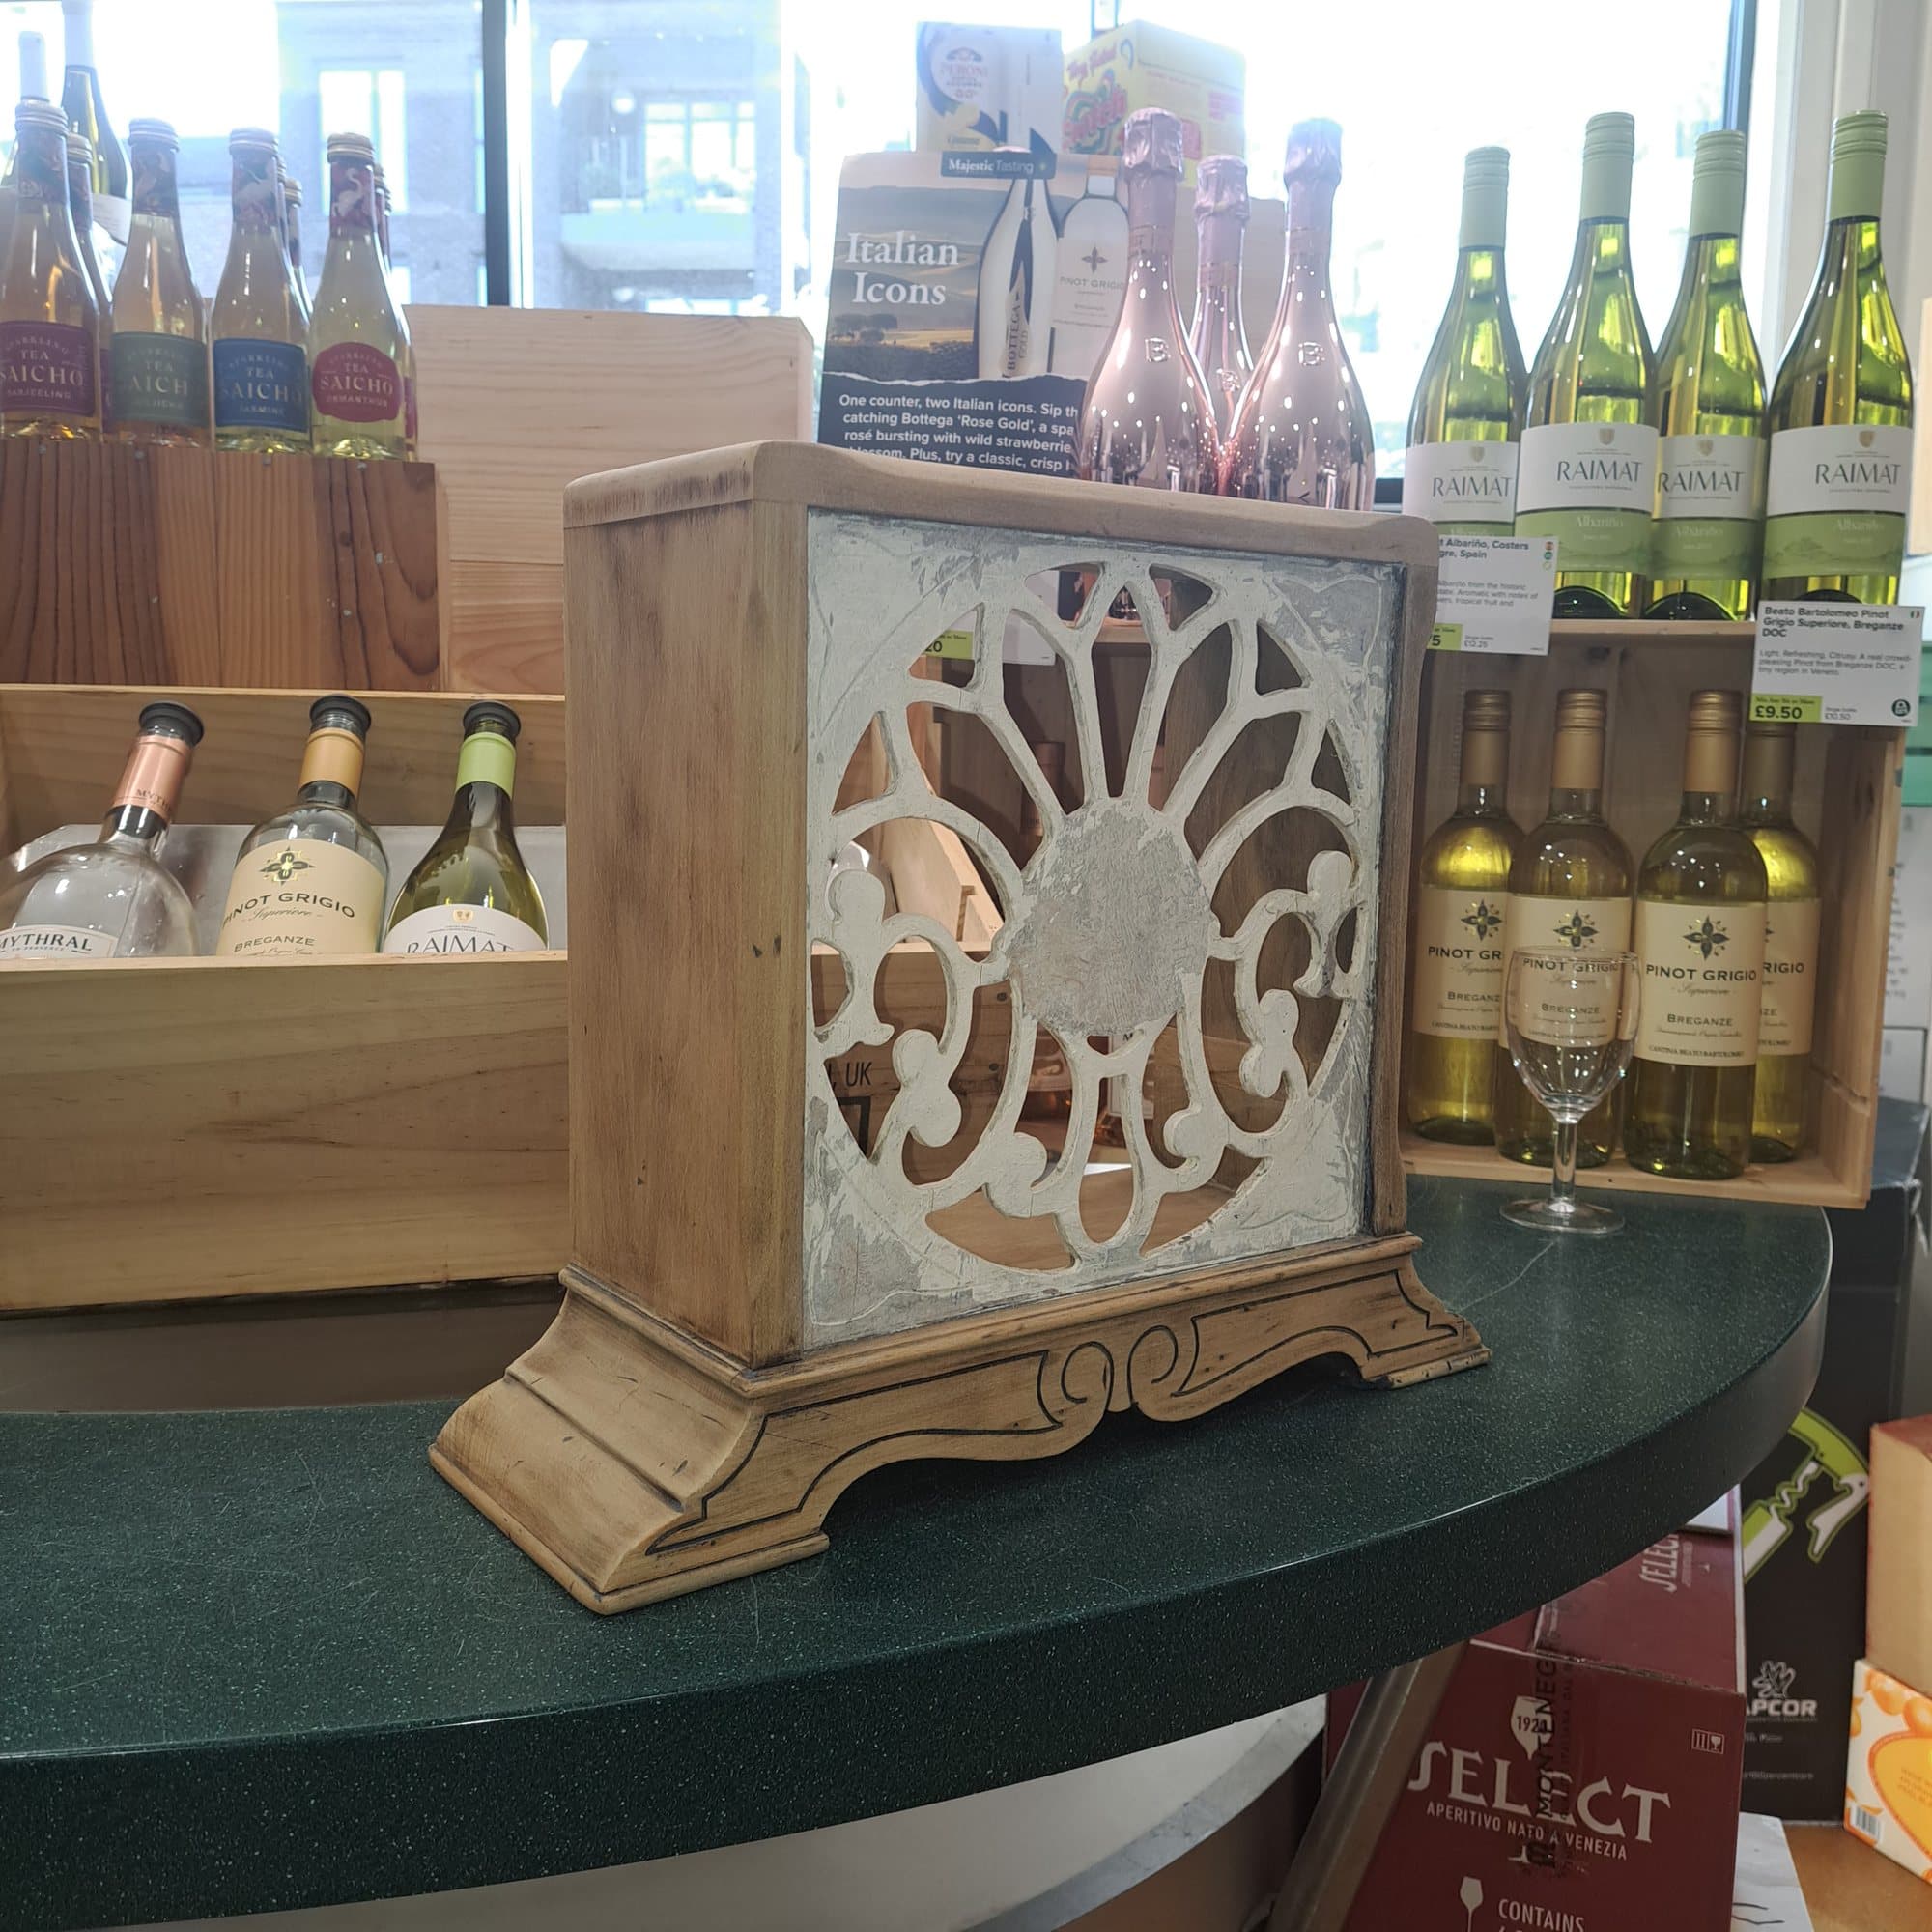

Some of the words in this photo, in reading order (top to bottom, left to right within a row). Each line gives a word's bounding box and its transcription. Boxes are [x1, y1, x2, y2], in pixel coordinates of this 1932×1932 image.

[948, 158, 994, 173] Majestic
[995, 159, 1034, 174] Tasting
[845, 231, 958, 266] Italian
[852, 272, 946, 305] Icons
[21, 349, 49, 360] TEA
[246, 366, 274, 379] TEA
[344, 362, 369, 373] TEA
[321, 375, 394, 395] SAICHO
[839, 394, 867, 407] One
[869, 396, 922, 409] counter,
[925, 398, 950, 409] two
[953, 398, 994, 411] Italian
[998, 400, 1037, 413] icons.
[1040, 403, 1062, 418] Sip
[1065, 405, 1078, 417] th
[843, 412, 897, 426] catching
[901, 413, 953, 427] Bottega
[1038, 423, 1047, 433] a
[1051, 425, 1074, 438] spa
[844, 429, 872, 440] rosé
[876, 430, 929, 444] bursting
[933, 432, 961, 444] with
[965, 434, 993, 446] wild
[996, 436, 1072, 454] strawberrie
[910, 448, 941, 462] Plus,
[945, 450, 963, 464] try
[966, 454, 975, 463] a
[978, 452, 1027, 468] classic,
[1030, 456, 1062, 471] crisp
[1556, 460, 1643, 482] RAIMAT
[1815, 462, 1901, 484] RAIMAT
[1433, 476, 1513, 497] RAIMAT
[1657, 470, 1746, 493] RAIMAT
[1446, 538, 1490, 549] Albariño,
[1492, 540, 1529, 550] Costers
[1438, 550, 1457, 558] gre,
[1460, 550, 1487, 559] Spain
[1765, 607, 1795, 615] Beato
[1798, 607, 1858, 618] Bartolomeo
[1861, 609, 1889, 618] Pinot
[1762, 628, 1787, 637] DOC
[1763, 617, 1795, 627] Grigio
[1797, 618, 1851, 629] Superiore,
[1853, 620, 1904, 631] Breganze
[1755, 705, 1803, 719] £9.50
[278, 893, 355, 918] GRIGIO
[234, 935, 315, 952] BREGANZE
[1428, 946, 1473, 959] PINOT
[1523, 957, 1566, 971] PINOT
[1646, 964, 1696, 980] PINOT
[1703, 969, 1756, 981] GRIGIO
[1763, 962, 1804, 974] RIGIO
[1667, 1013, 1733, 1027] BREGANZE
[846, 1062, 872, 1087] UK
[1407, 1741, 1671, 1843] SELECT
[1426, 1801, 1501, 1832] APERITIVO
[1507, 1821, 1544, 1841] NATO
[1565, 1834, 1627, 1861] VENEZIA
[1498, 1898, 1584, 1932] CONTAINS
